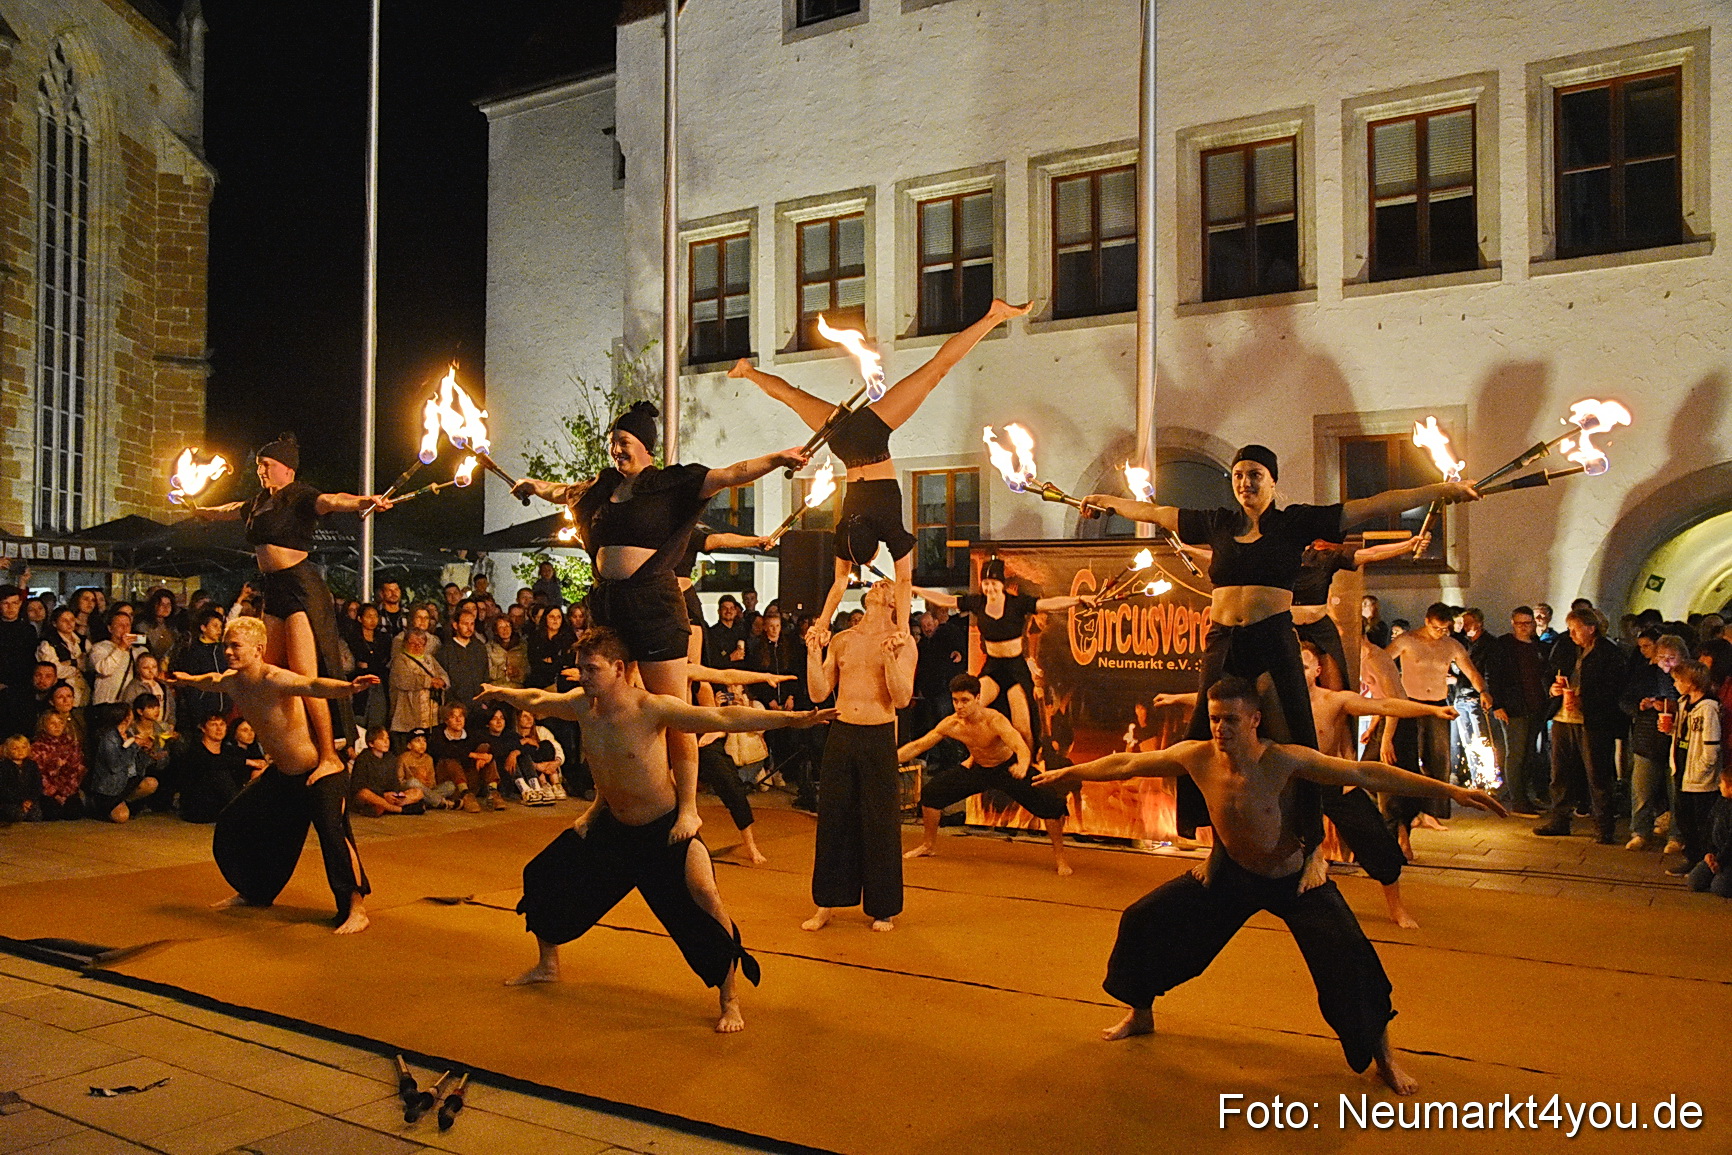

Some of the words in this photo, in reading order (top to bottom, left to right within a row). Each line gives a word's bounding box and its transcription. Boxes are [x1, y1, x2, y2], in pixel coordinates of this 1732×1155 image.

[1068, 569, 1212, 665] Circusvere
[1098, 657, 1163, 670] Neumarkt
[1166, 659, 1191, 670] e.V.
